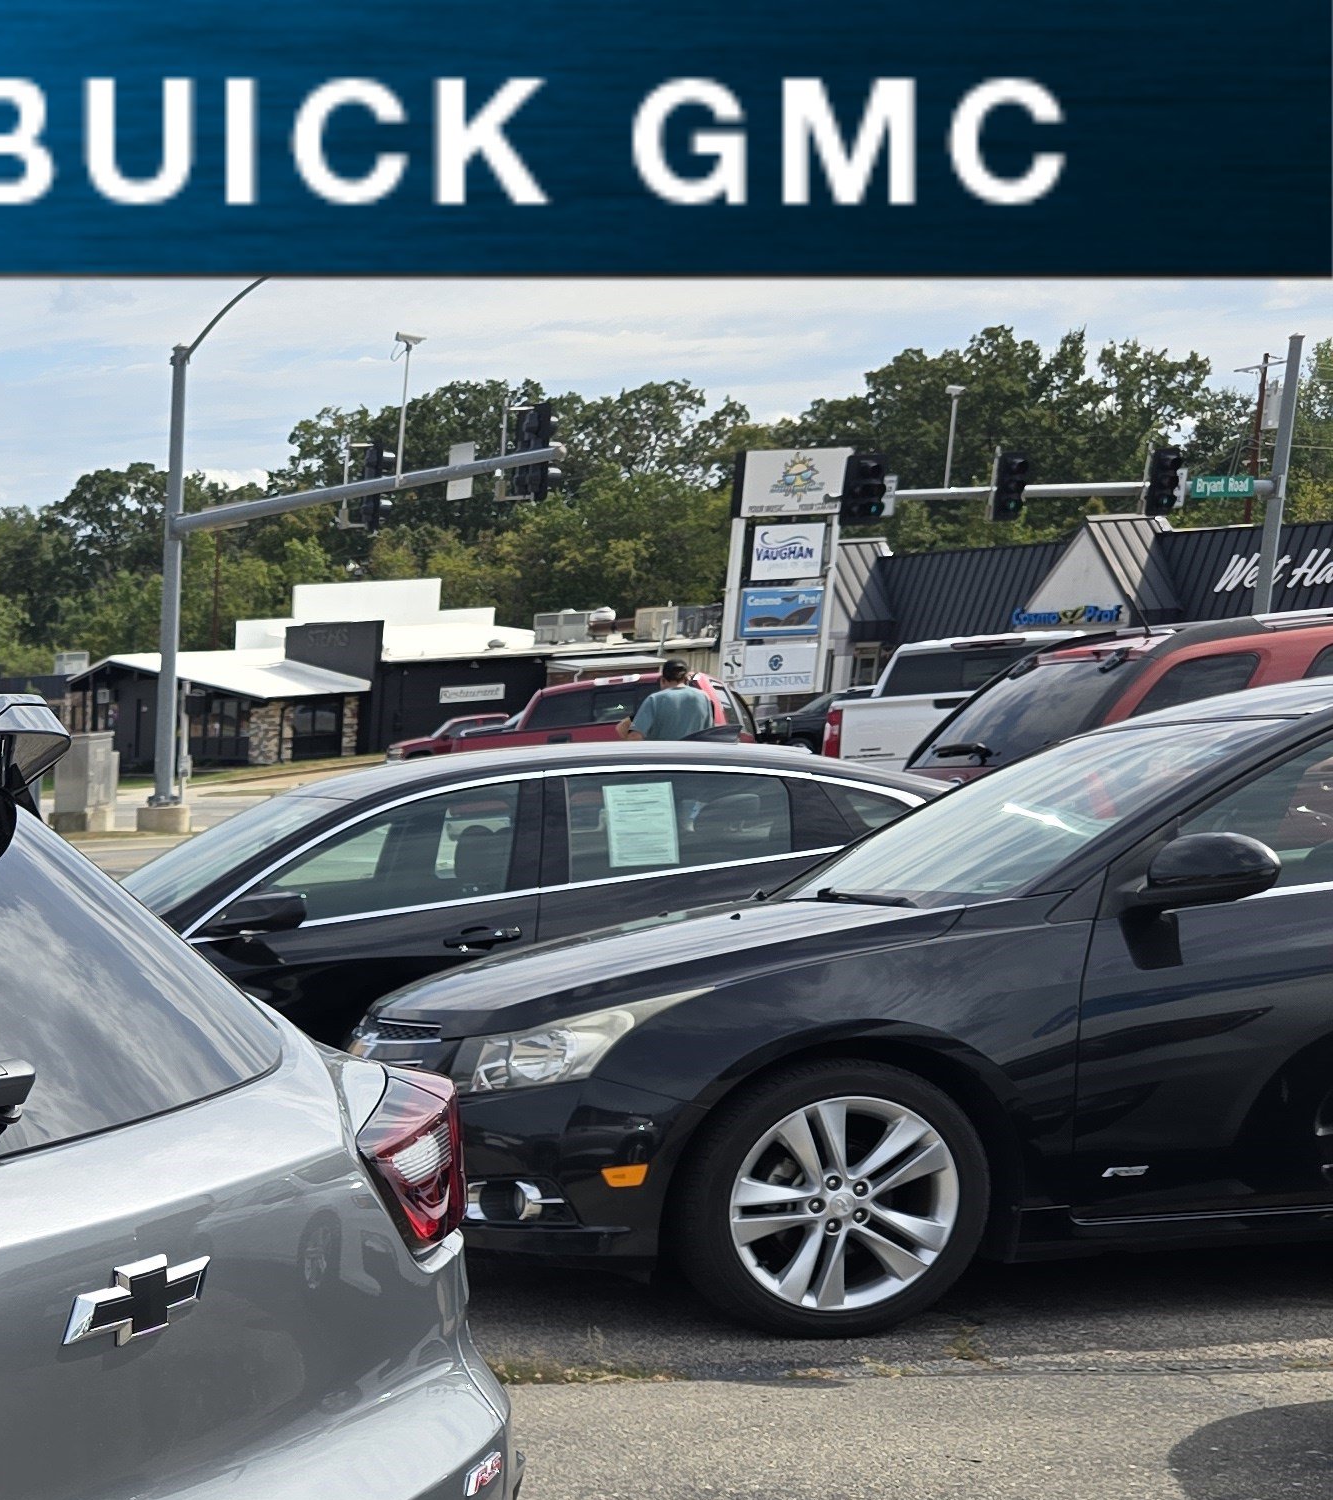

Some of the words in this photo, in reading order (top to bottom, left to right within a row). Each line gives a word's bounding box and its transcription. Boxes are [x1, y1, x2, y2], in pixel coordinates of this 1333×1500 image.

[1195, 477, 1225, 497] Bryant
[1227, 476, 1250, 493] Road
[755, 546, 814, 561] VAUGHAN
[1213, 552, 1292, 593] Wet
[1012, 607, 1061, 625] Cosmo
[1084, 604, 1123, 623] Prof
[737, 675, 811, 690] CENTERSTONE
